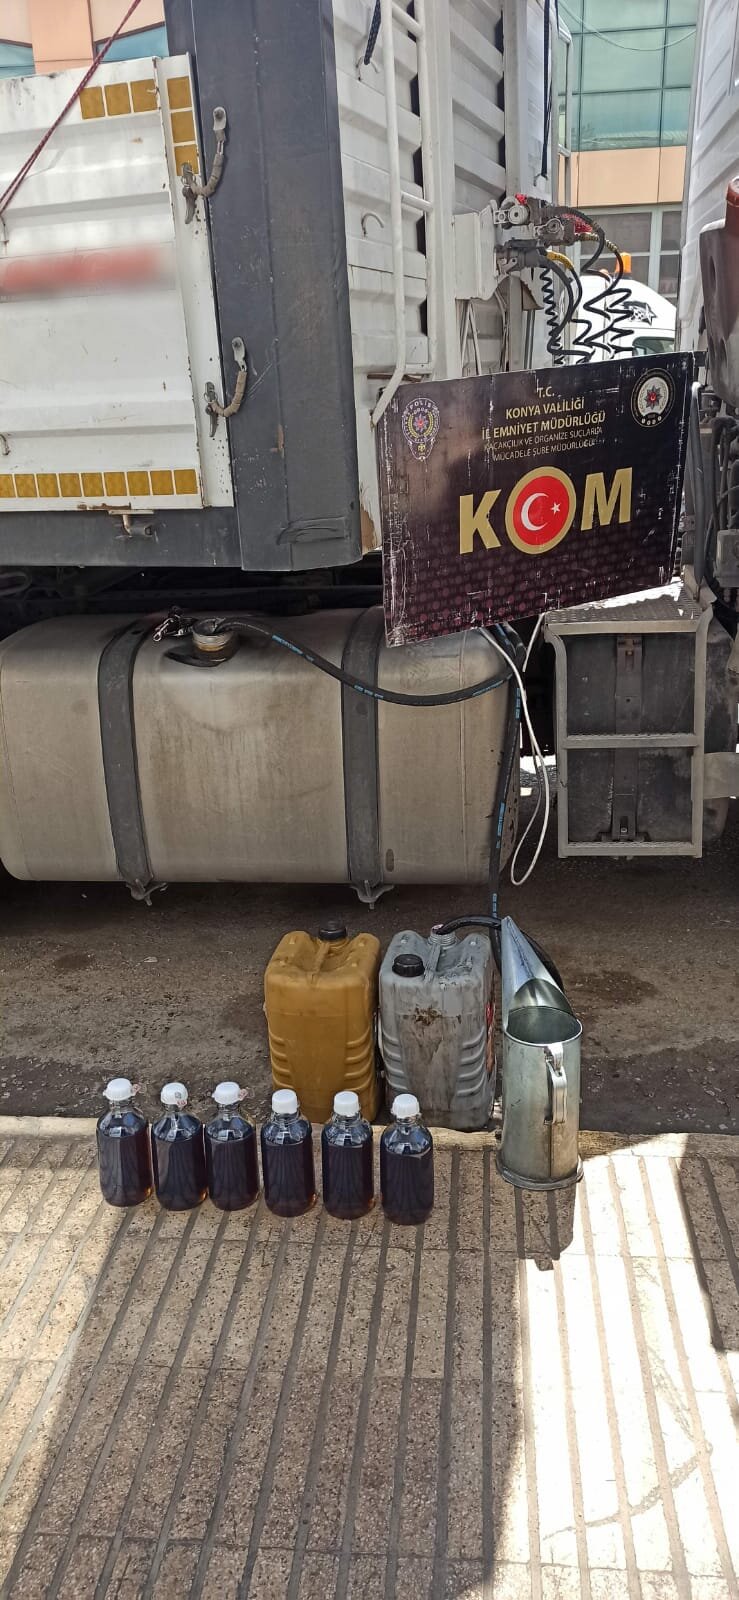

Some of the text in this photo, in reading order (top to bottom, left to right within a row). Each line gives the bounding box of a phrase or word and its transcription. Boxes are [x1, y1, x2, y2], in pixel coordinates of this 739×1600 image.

[537, 386, 555, 398] T.C.
[505, 396, 585, 420] KONYA VALİLİĞİ
[482, 410, 606, 440] İL EMNİYET MÜDÜRLÜĞÜ
[524, 436, 533, 445] VE
[459, 466, 633, 555] KOM
